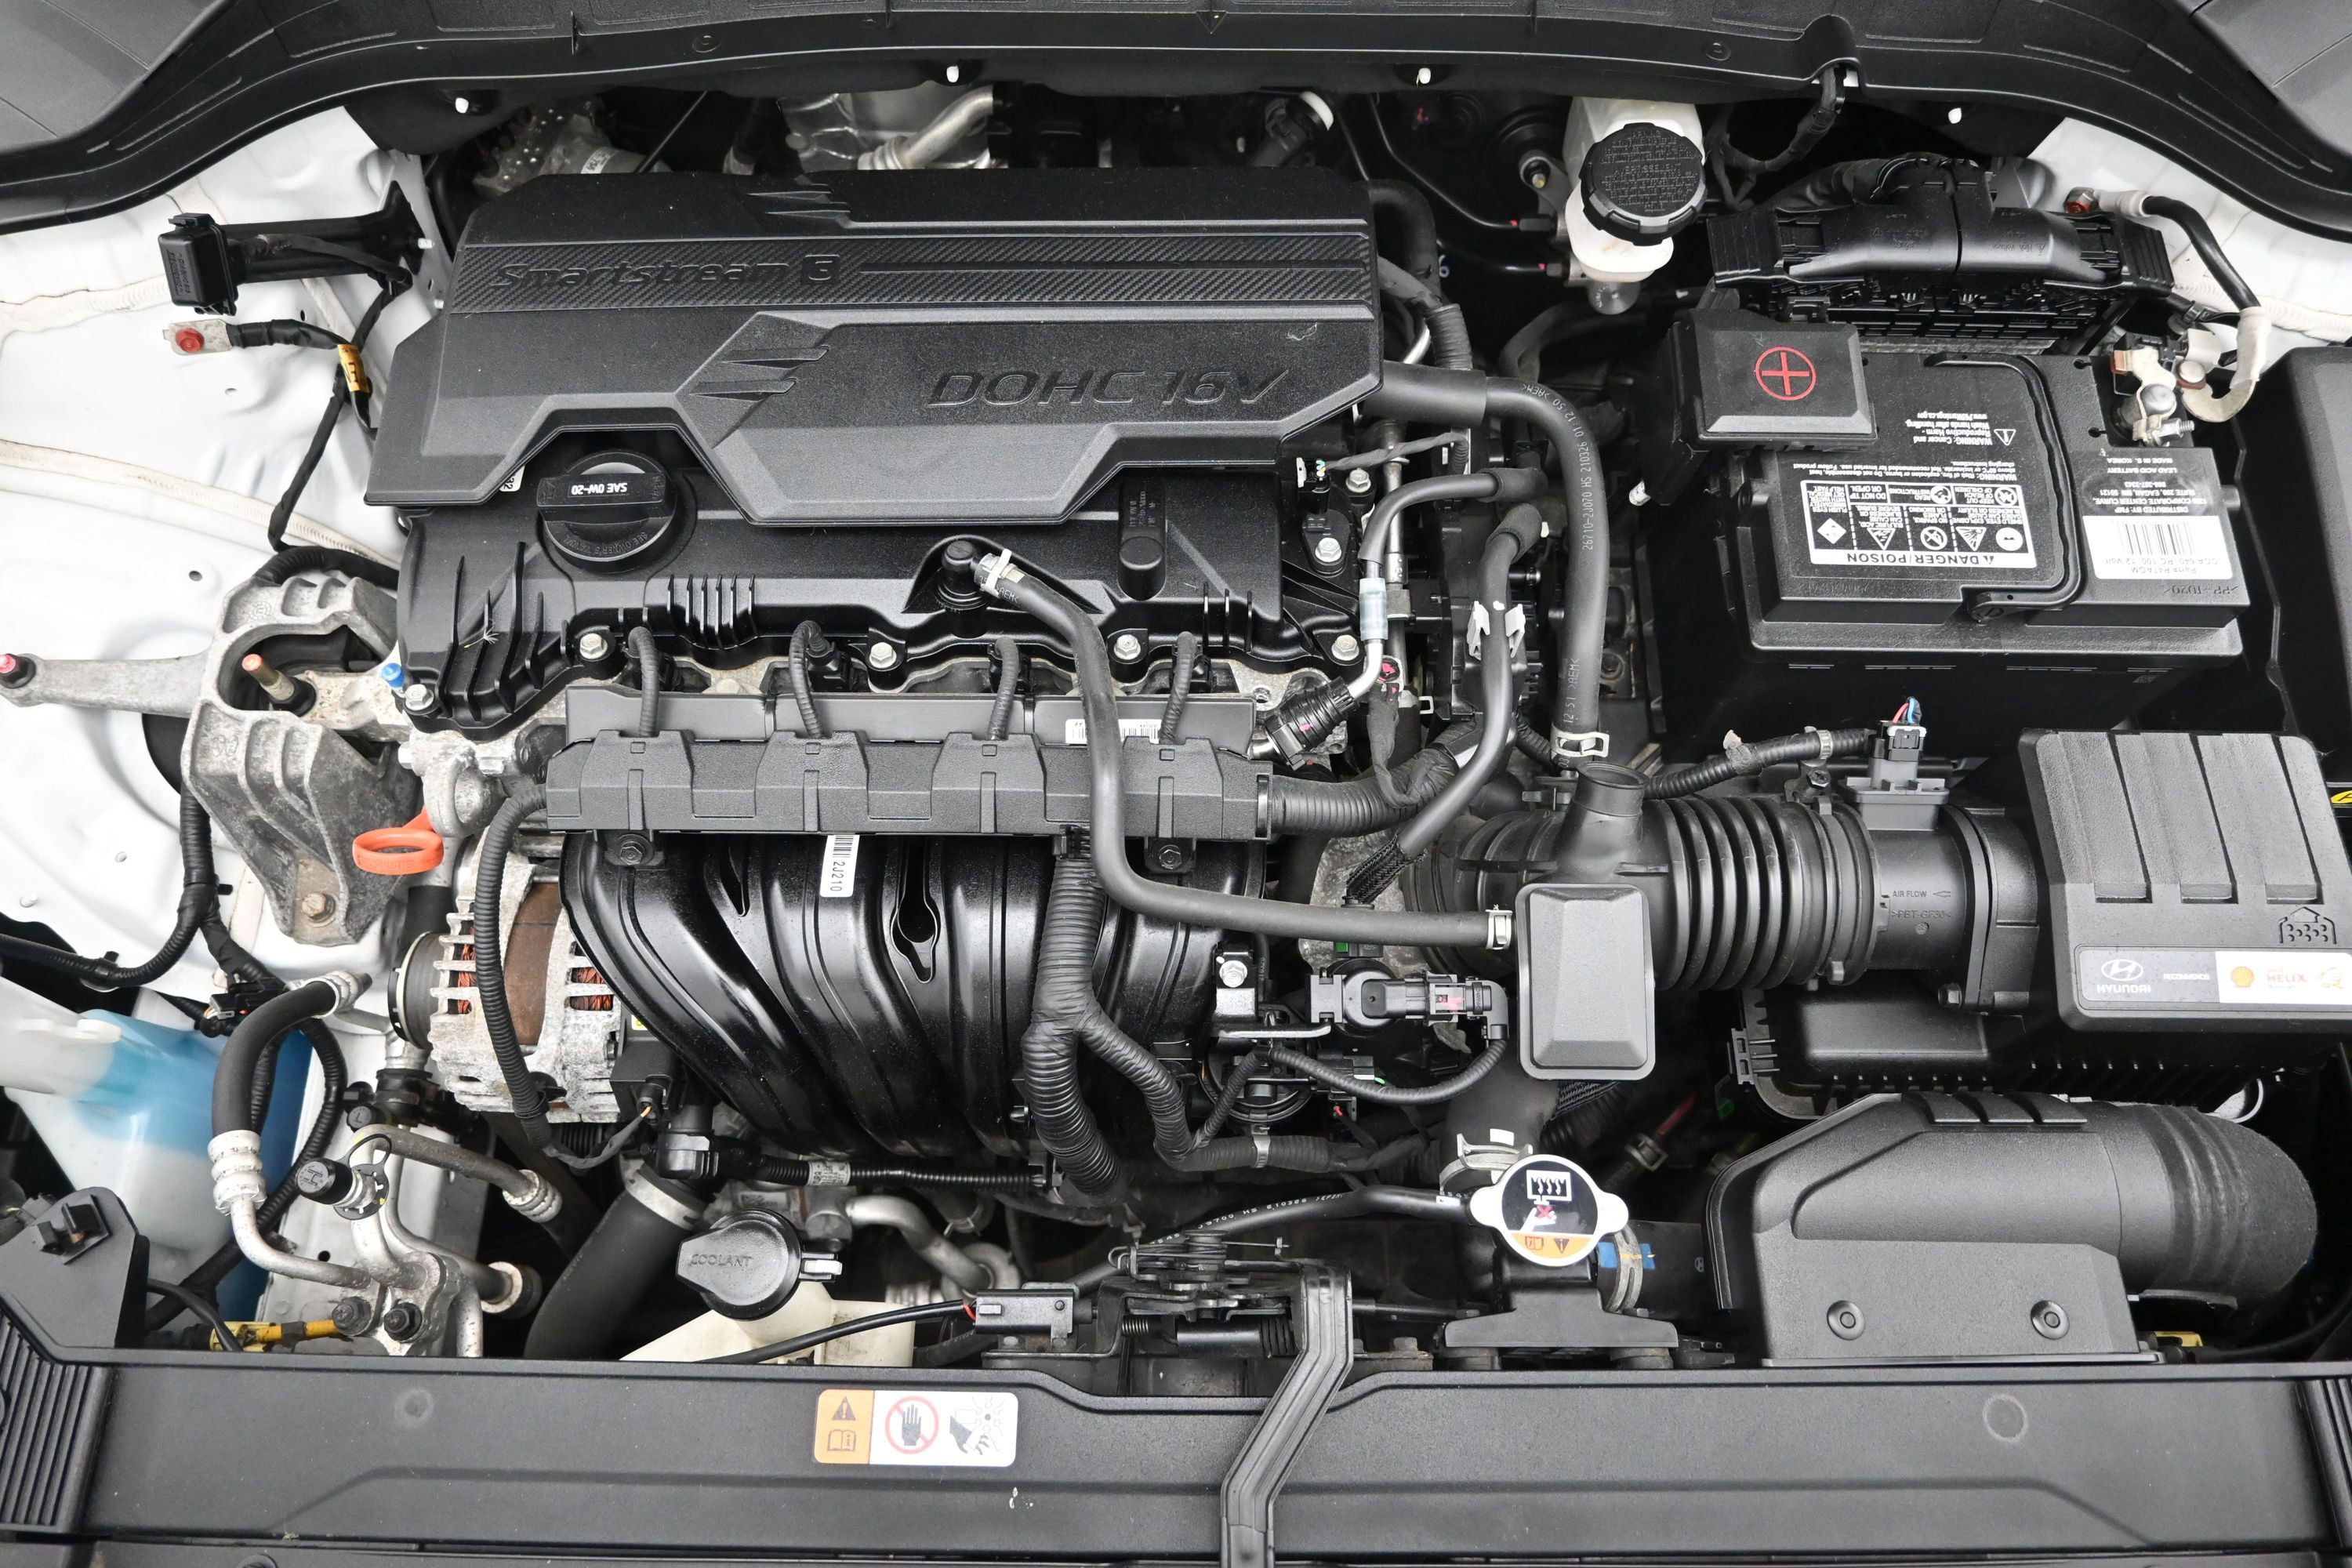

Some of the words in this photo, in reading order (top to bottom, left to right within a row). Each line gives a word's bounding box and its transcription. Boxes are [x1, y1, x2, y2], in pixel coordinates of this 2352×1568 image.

[488, 260, 789, 286] Smartstream
[805, 255, 839, 282] G
[927, 372, 1146, 407] DOHC
[1163, 370, 1289, 405] 16V
[1945, 429, 1991, 437] Reproductive
[1953, 437, 1993, 445] WARNING:
[1577, 441, 1592, 473] 210326
[1581, 476, 1592, 488] HS
[1976, 473, 2017, 481] WARNING:
[571, 483, 605, 495] 0W-20
[607, 482, 628, 493] SAE
[1581, 492, 1593, 550] 26710-2J070
[830, 862, 846, 891] 2J210
[2267, 974, 2307, 982] HELIX
[2096, 984, 2151, 993] HYUNDAI
[303, 1168, 323, 1186] H
[691, 1254, 753, 1267] COOLANT
